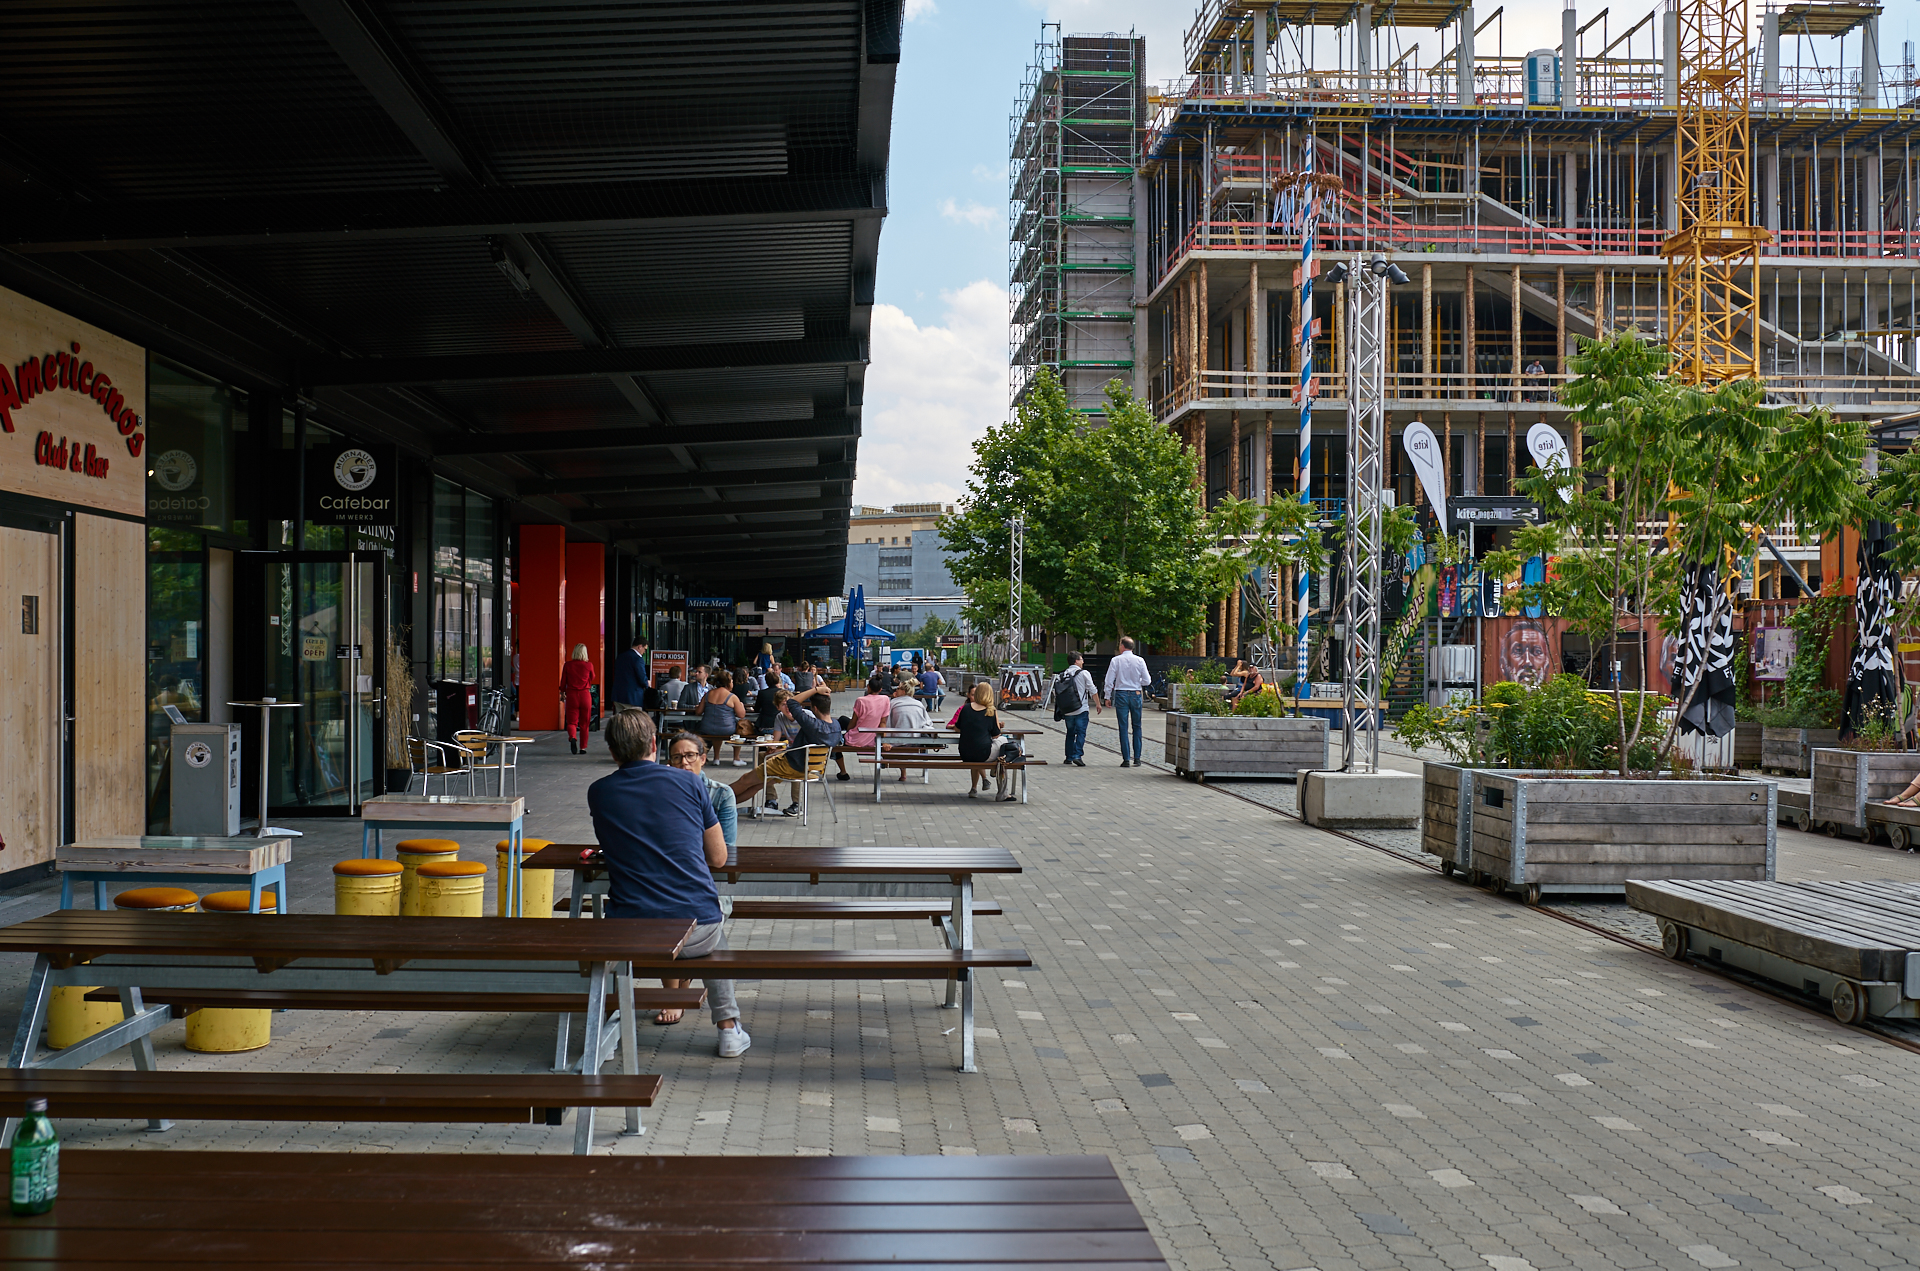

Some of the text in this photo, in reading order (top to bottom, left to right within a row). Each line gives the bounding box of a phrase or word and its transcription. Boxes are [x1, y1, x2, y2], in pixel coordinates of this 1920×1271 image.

[36, 431, 109, 479] Club & Bar
[336, 451, 375, 470] MURNAUER
[320, 495, 390, 510] Cafebar
[1456, 508, 1502, 520] kite magazin
[688, 599, 709, 607] Mitte
[304, 649, 325, 657] OPEN
